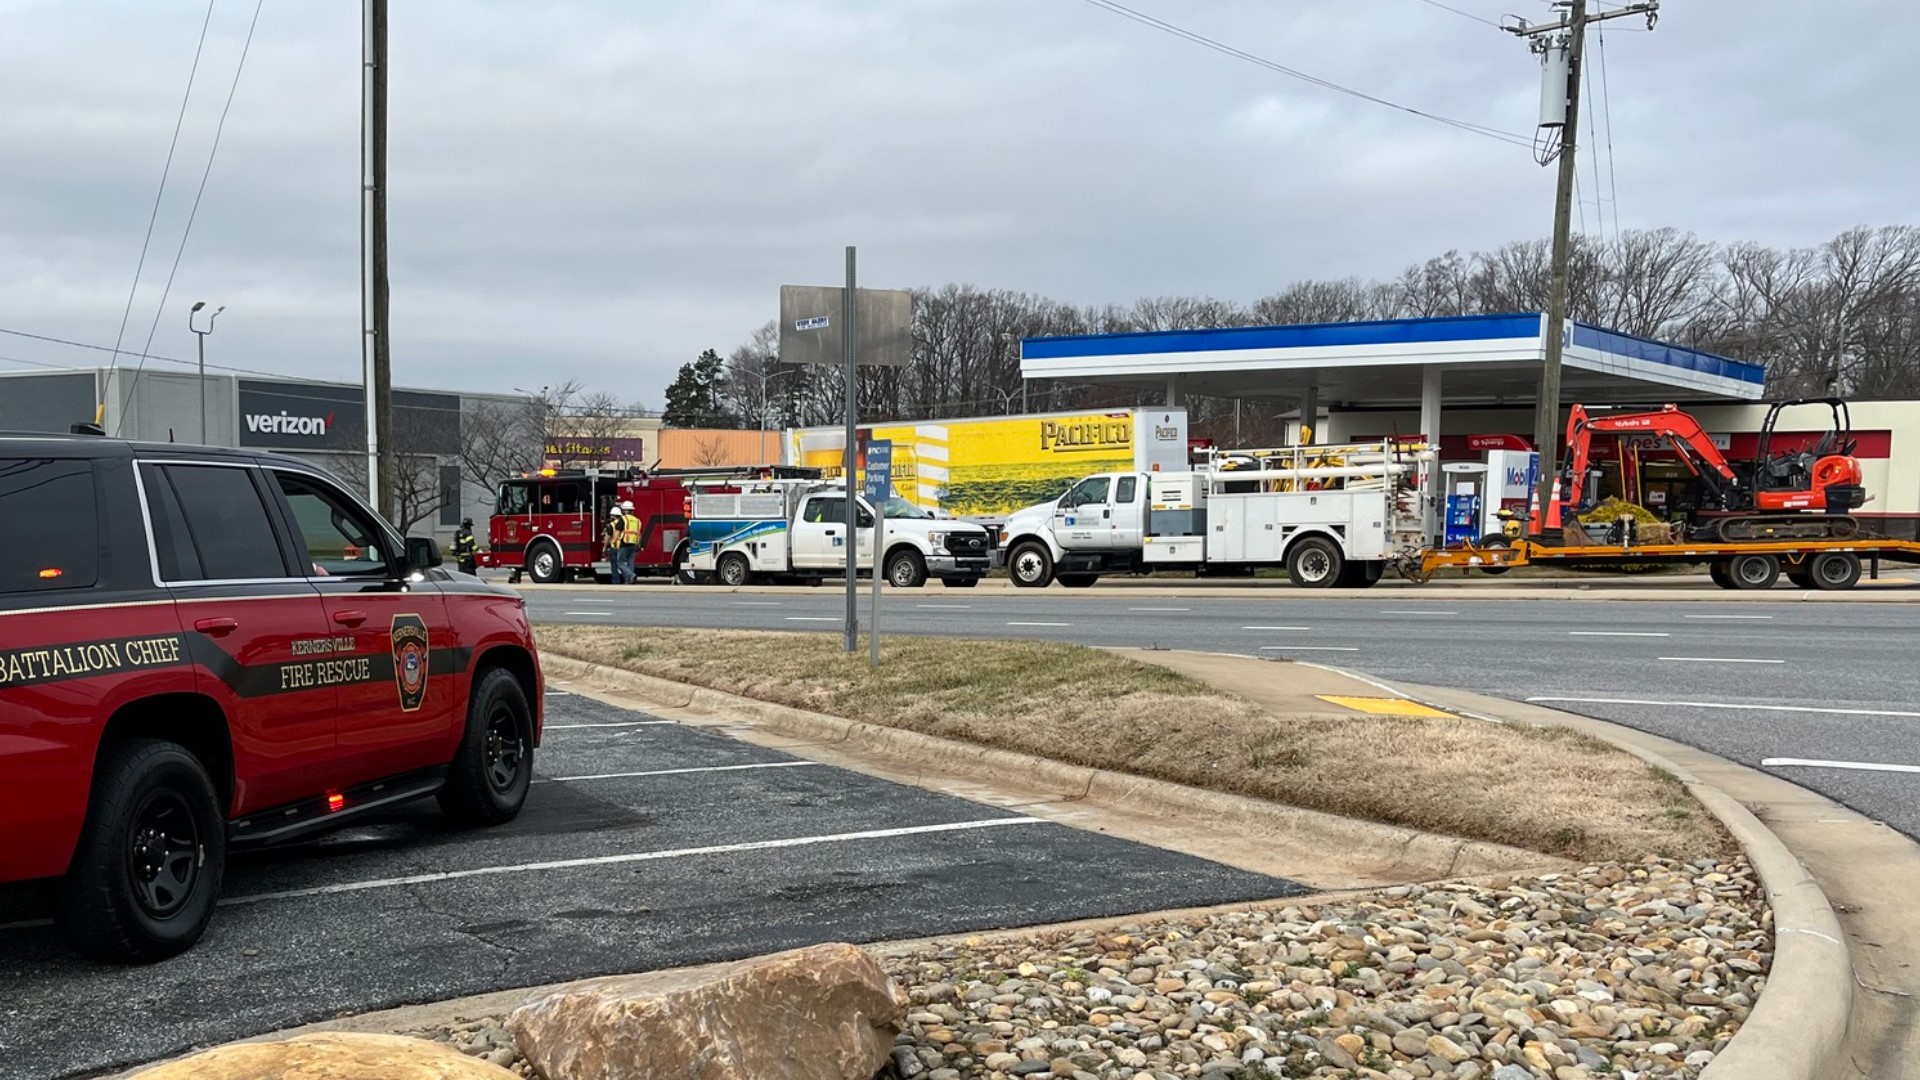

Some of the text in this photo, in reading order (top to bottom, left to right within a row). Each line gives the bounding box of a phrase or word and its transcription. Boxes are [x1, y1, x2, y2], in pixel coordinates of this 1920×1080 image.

[245, 410, 326, 435] verizon
[1040, 421, 1132, 450] PACIFICO
[866, 461, 890, 471] Customer
[866, 473, 886, 485] Parking
[291, 636, 356, 656] KERNERSVILLE
[0, 637, 180, 683] BATTALION CHIEF
[280, 658, 371, 689] FIRE RESCUE
